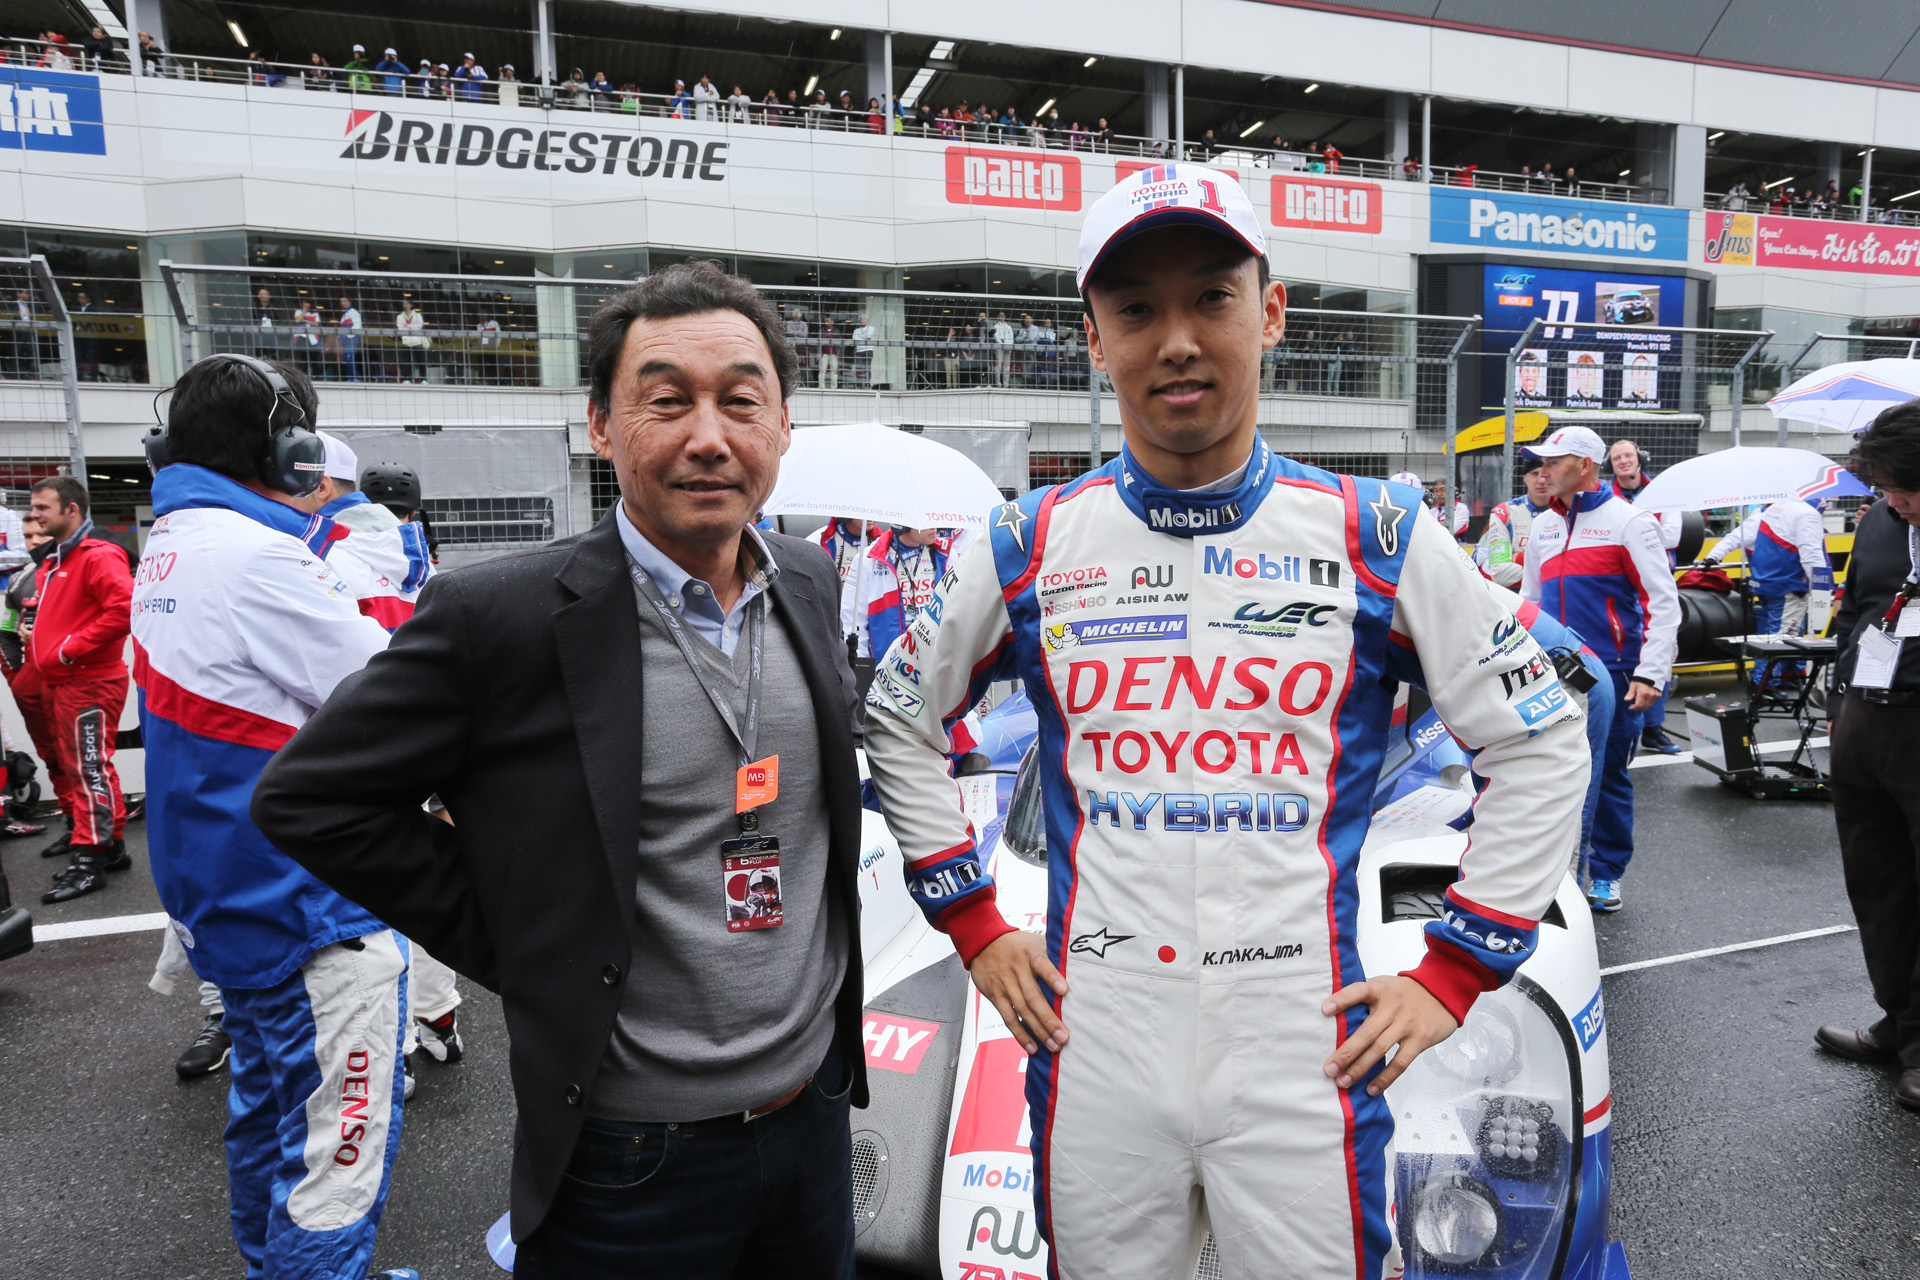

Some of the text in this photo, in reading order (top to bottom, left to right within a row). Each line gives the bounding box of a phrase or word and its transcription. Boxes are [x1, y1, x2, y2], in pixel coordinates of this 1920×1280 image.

[339, 109, 730, 181] BRIDGESTONE
[1131, 182, 1187, 197] TOYOTA
[1131, 189, 1188, 205] HYBRID
[1197, 178, 1226, 217] 1
[1470, 198, 1656, 252] Panasonic
[1764, 243, 1783, 255] Your
[1784, 245, 1798, 254] Car
[1542, 290, 1579, 339] 77
[1553, 433, 1565, 445] 1
[784, 502, 902, 518] www.toyotahybridracing.com
[1704, 497, 1740, 505] TOYOTA
[926, 513, 964, 522] TOYOTA
[1150, 508, 1218, 528] Mobil
[1582, 528, 1610, 536] DENSO
[1204, 546, 1300, 582] Mobil
[1041, 566, 1107, 588] TOYOTA
[1076, 580, 1108, 590] Racing
[1116, 594, 1189, 605] AISIN AW
[1234, 602, 1338, 626] WEC
[1082, 620, 1184, 638] MICHELIN
[1238, 629, 1296, 638] CHAMPIONSHIP
[1250, 624, 1298, 632] ENDURANCE
[1478, 644, 1508, 666] FIA WORLD
[1498, 648, 1553, 700] JTEK
[1066, 656, 1333, 716] DENSO
[83, 724, 105, 791] Audi Sport
[1081, 730, 1309, 775] TOYOTA
[747, 772, 766, 782] GW
[1087, 790, 1310, 832] HYBRID
[872, 870, 879, 891] 1
[1202, 944, 1302, 966] K.NAKAJIMA
[334, 1050, 368, 1166] DENSO
[963, 1164, 1032, 1192] Mobi
